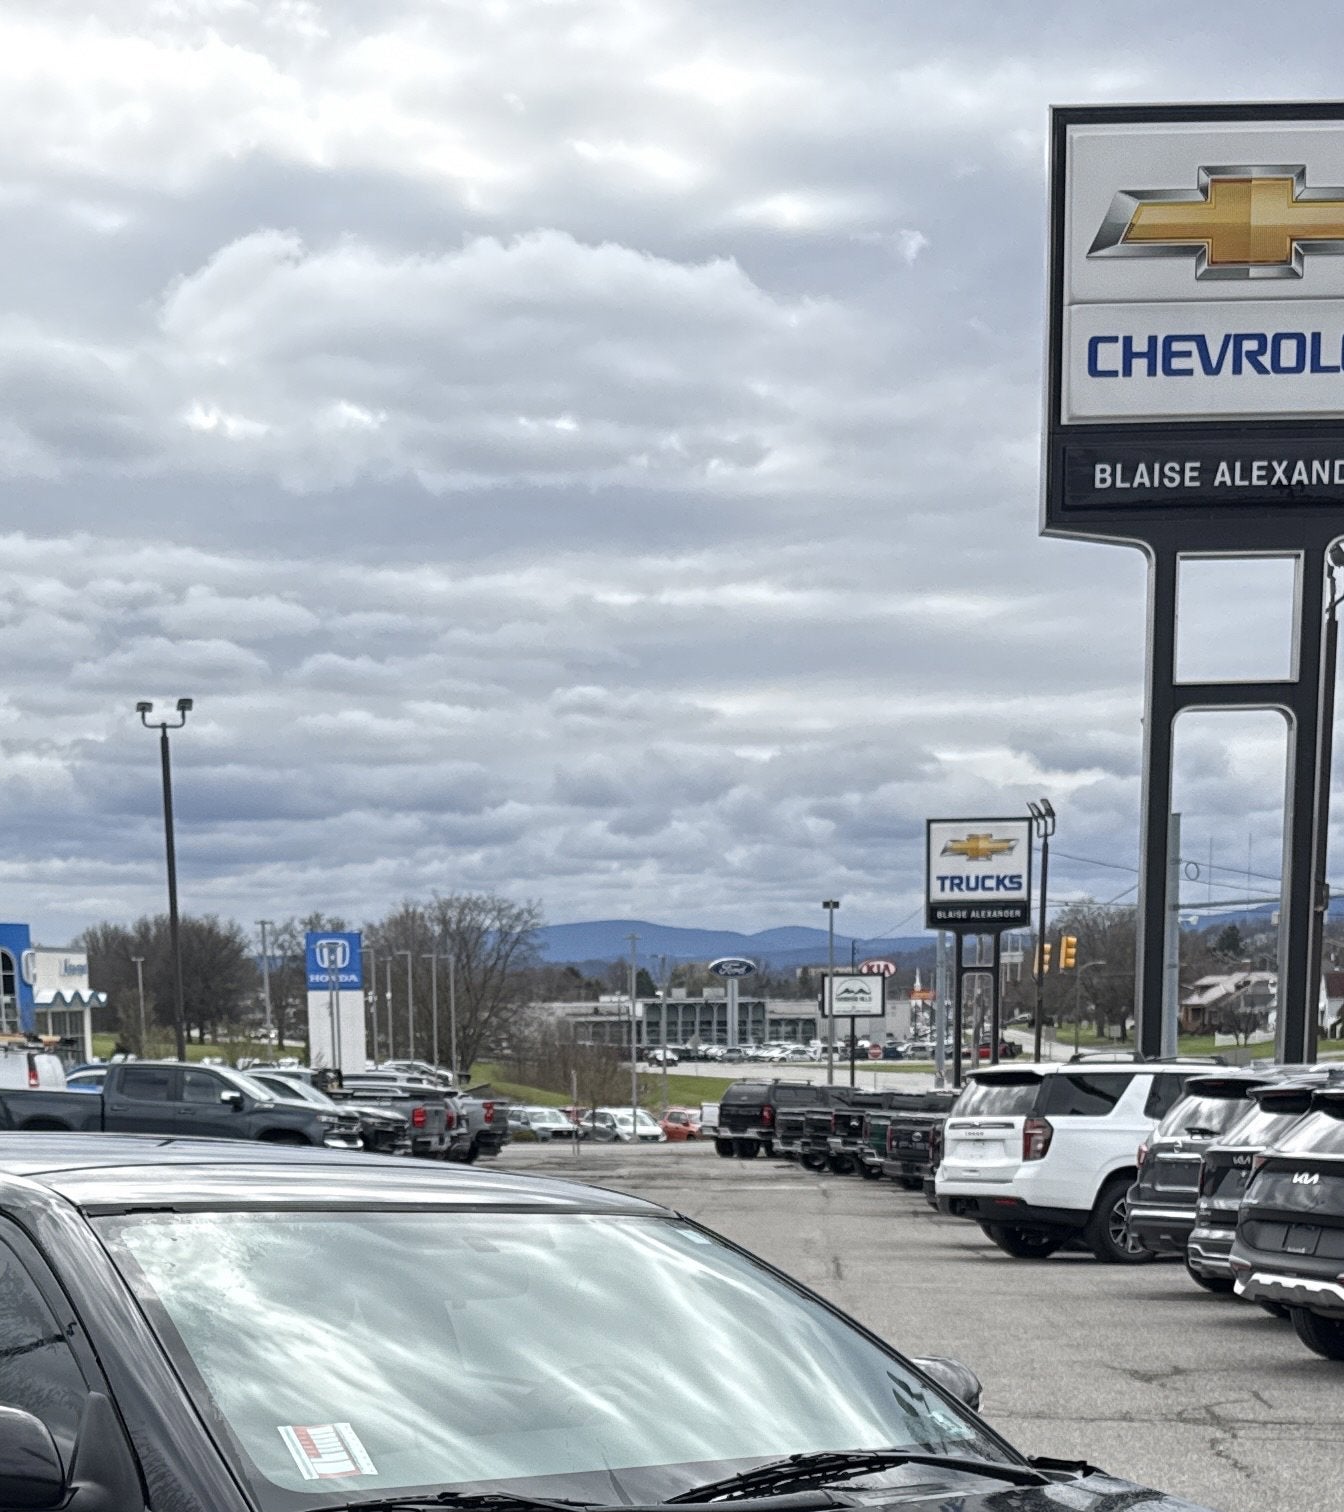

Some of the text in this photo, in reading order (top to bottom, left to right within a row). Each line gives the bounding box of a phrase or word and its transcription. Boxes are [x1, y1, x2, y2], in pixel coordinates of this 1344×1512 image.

[1093, 461, 1201, 489] BLAISE
[936, 874, 1023, 893] TRUCKS
[936, 909, 1022, 919] BLAISE ALEXANDER
[718, 963, 749, 976] Ford
[864, 963, 892, 975] KIA
